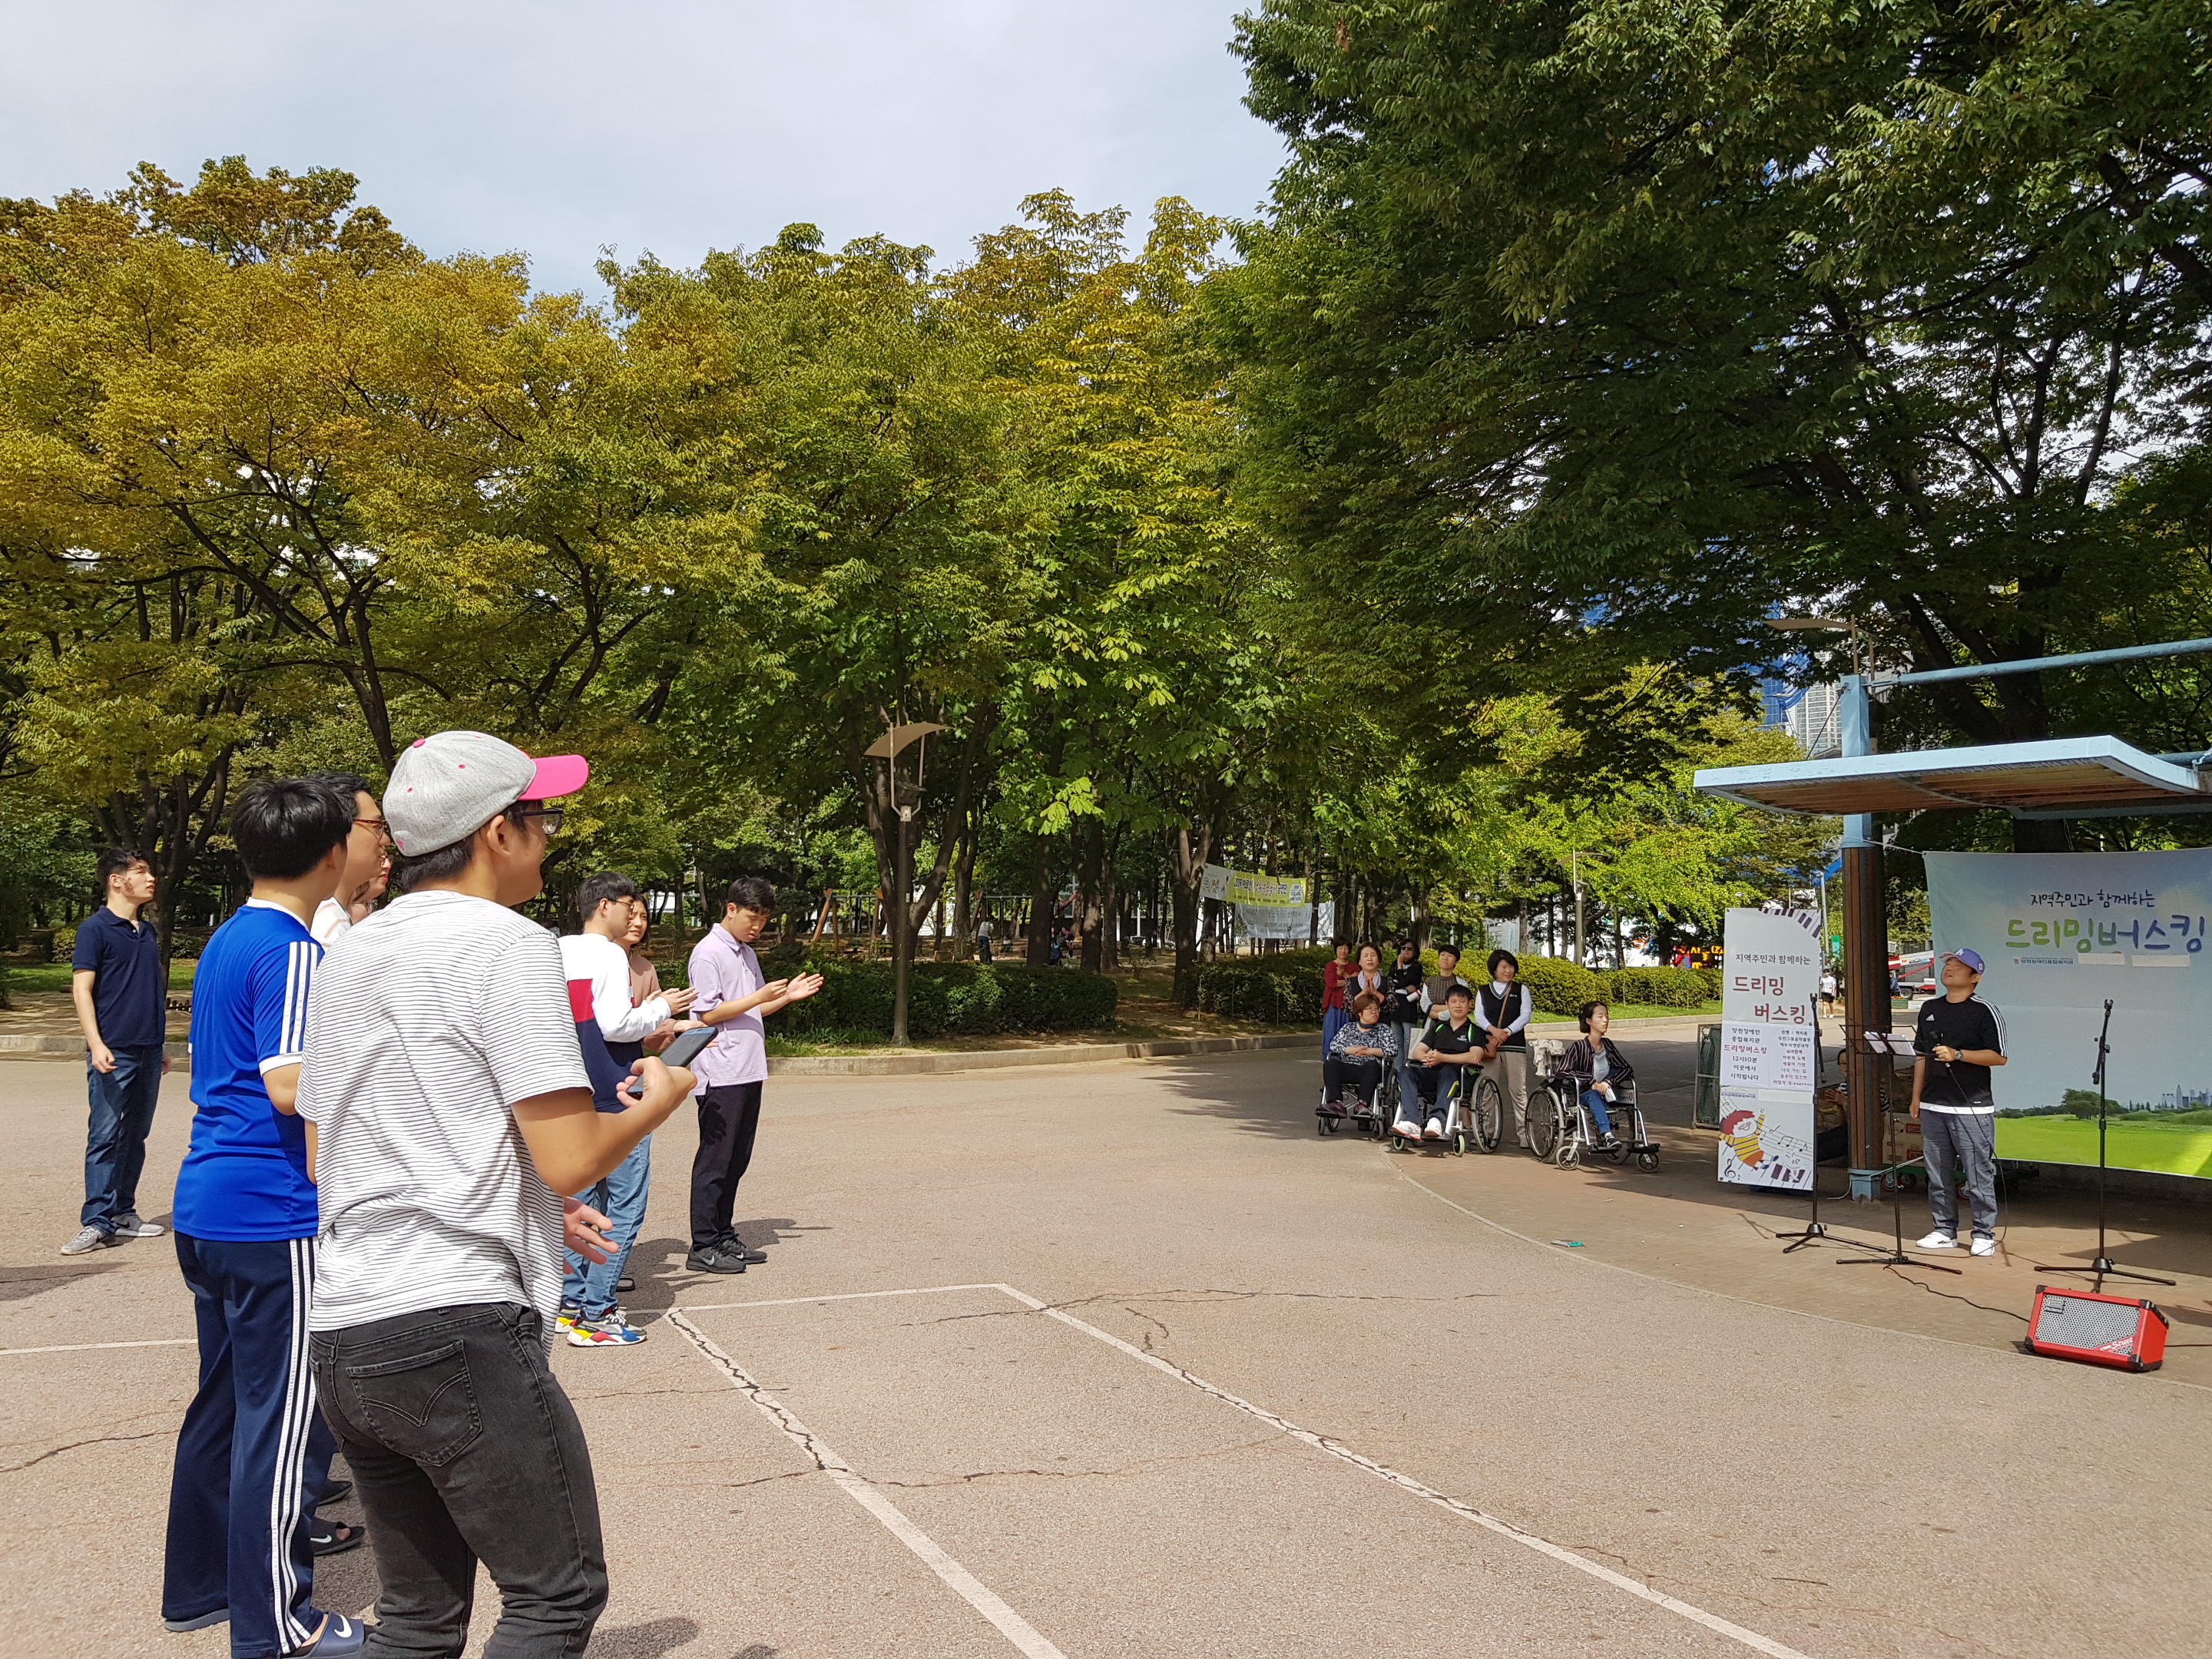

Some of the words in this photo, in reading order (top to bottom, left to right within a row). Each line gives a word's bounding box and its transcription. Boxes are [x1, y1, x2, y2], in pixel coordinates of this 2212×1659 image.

[2030, 891, 2094, 907] 지역주민과
[2096, 889, 2155, 908] 함께하는
[2005, 914, 2205, 954] 드리밍버스킹
[1735, 953, 1777, 964] 지역주민과
[1778, 955, 1811, 965] 함께하는
[1732, 975, 1784, 996] 드리밍
[1754, 1003, 1805, 1025] 버스킹
[1731, 1035, 1760, 1044] 종합복지관
[1724, 1044, 1767, 1055] 드리밍버스킹
[1730, 1072, 1759, 1081] 시작됩니다
